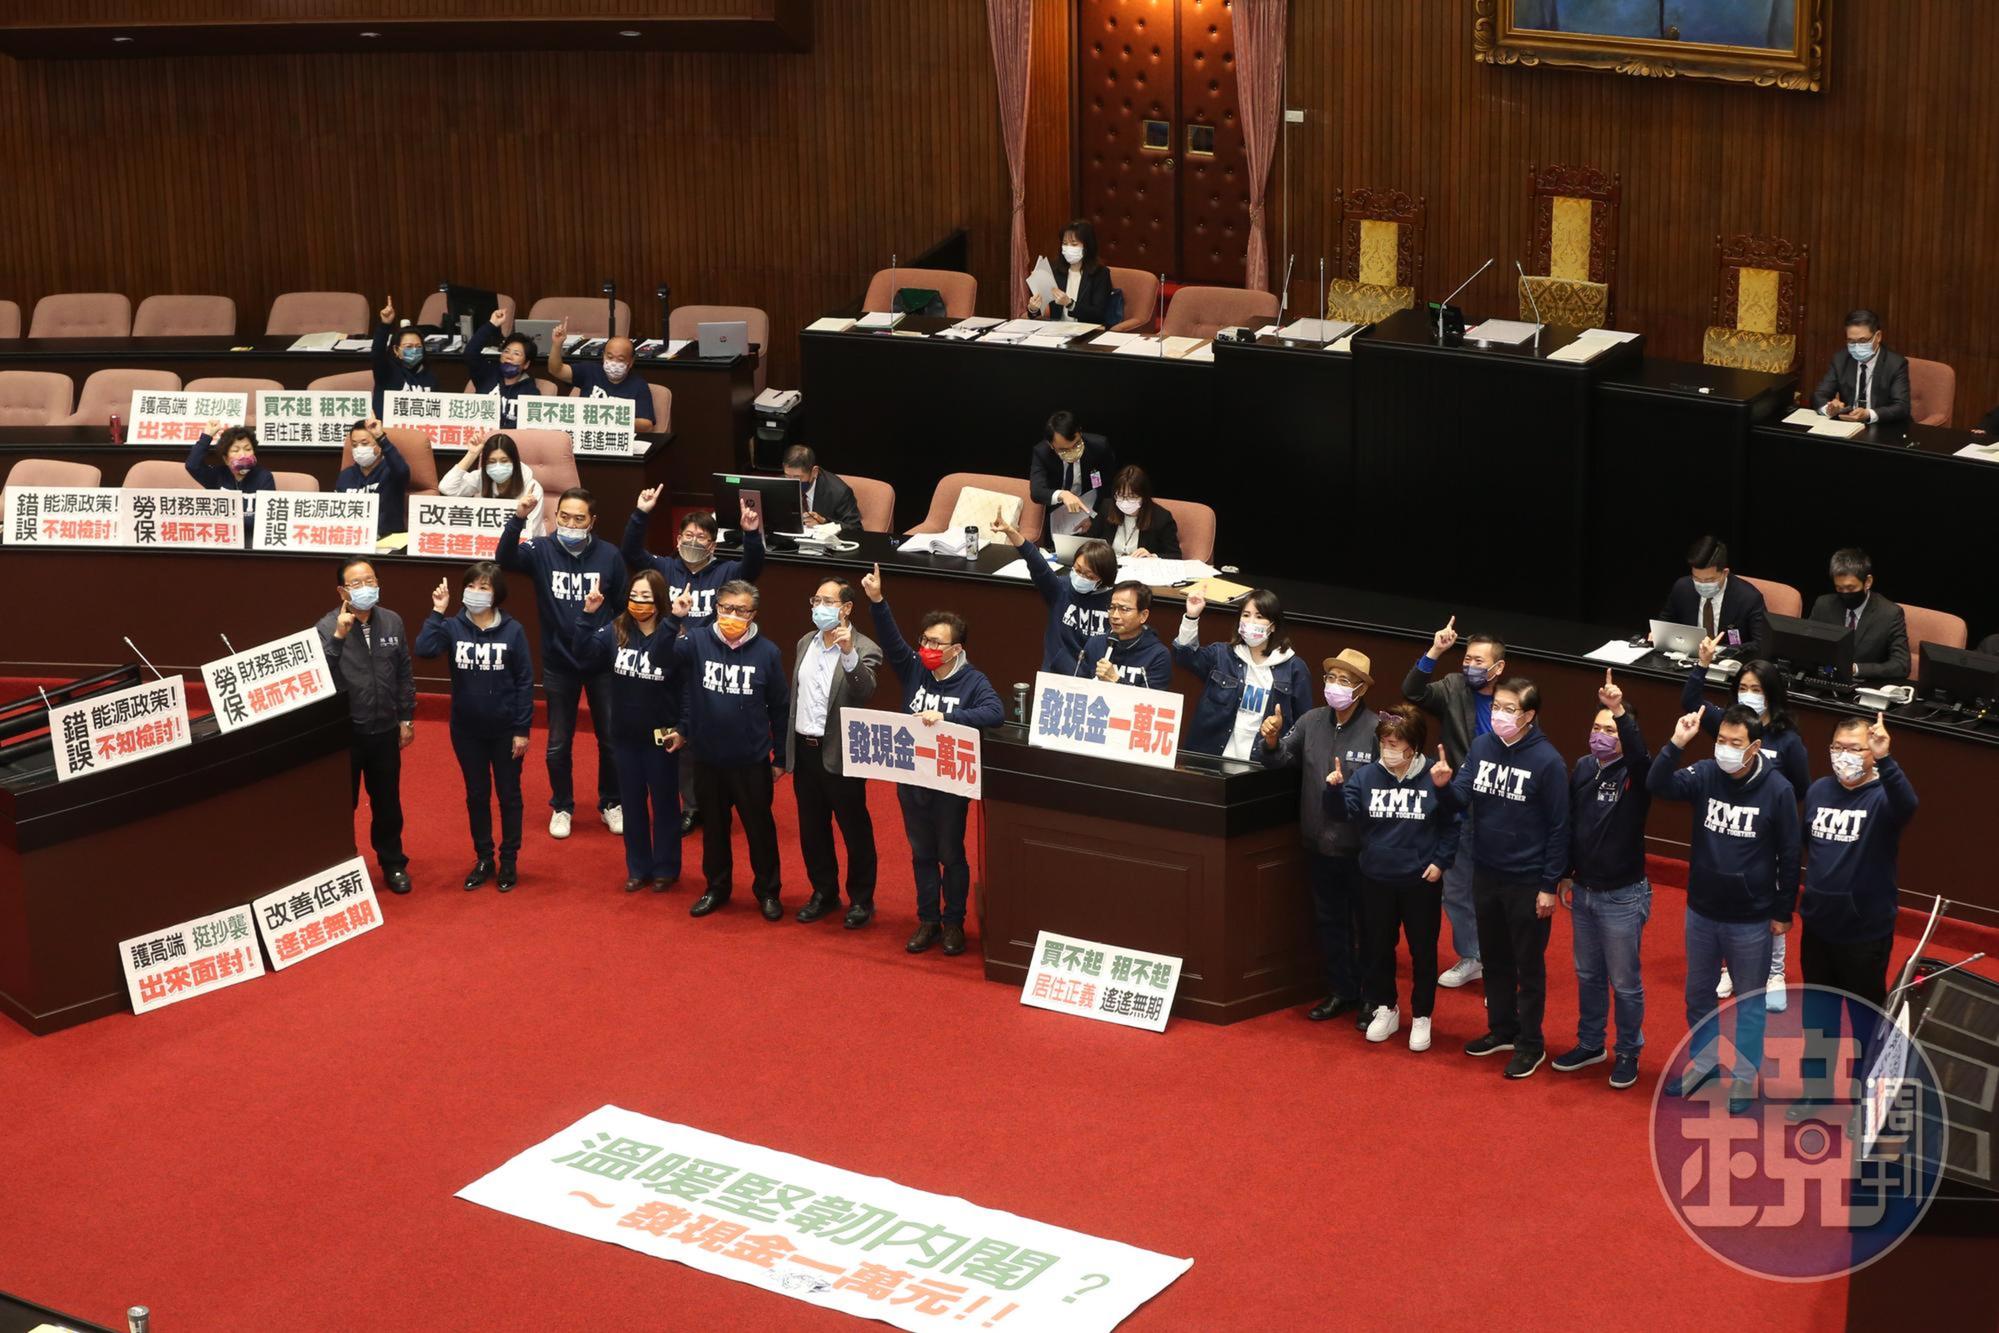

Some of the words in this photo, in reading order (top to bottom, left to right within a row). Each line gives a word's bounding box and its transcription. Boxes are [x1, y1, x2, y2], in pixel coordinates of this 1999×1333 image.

[140, 396, 187, 416] 護高端
[194, 398, 241, 417] 挺抄襲
[264, 397, 312, 416] 買不起
[320, 397, 366, 417] 租不起
[393, 397, 441, 417] 護高端
[448, 399, 495, 420] 挺抄襲
[526, 402, 575, 424] 買不起
[583, 404, 631, 426] 租不起
[137, 421, 230, 441] 出來面
[264, 423, 312, 442] 居住正義
[580, 430, 629, 452] 遙遙無期
[15, 493, 39, 541] 錯誤
[43, 494, 119, 513] 能源政策!
[160, 497, 236, 517] 財務黑洞!
[294, 499, 371, 519] 能源政策!
[42, 519, 118, 540] 不知檢討!
[133, 496, 156, 543] 勞保
[161, 522, 237, 543] 視而不見!
[265, 498, 289, 546] 錯誤
[292, 524, 369, 546] 不知檢討!
[418, 532, 529, 556] 遙遙無
[551, 570, 600, 595] KMT
[238, 639, 315, 684] 財務黑洞!
[455, 641, 507, 664] KMT
[614, 646, 662, 675] KM
[703, 660, 755, 689] KMT
[212, 665, 248, 725] 勞保
[247, 669, 323, 714] 視而不見!
[91, 687, 178, 730] 能源政策!
[1038, 687, 1177, 756] 發現金一萬元
[62, 710, 94, 773] 錯誤
[95, 717, 182, 760] 不知檢討!
[848, 720, 977, 785] 發現金一萬元
[1473, 760, 1531, 795] KMT
[1368, 787, 1427, 813] KMT
[1704, 797, 1760, 831] KMT
[1811, 806, 1867, 836] KMT
[264, 870, 364, 931] 改善低薪
[131, 932, 187, 970] 護高端
[192, 913, 249, 951] 挺抄襲
[275, 900, 376, 962] 遙遙無期
[138, 946, 255, 1003] 出來面對!
[1040, 940, 1104, 977] 買不起
[1110, 955, 1172, 990] 租不起
[1032, 972, 1096, 1009] 居住正義
[1099, 986, 1164, 1021] 遙遙無期
